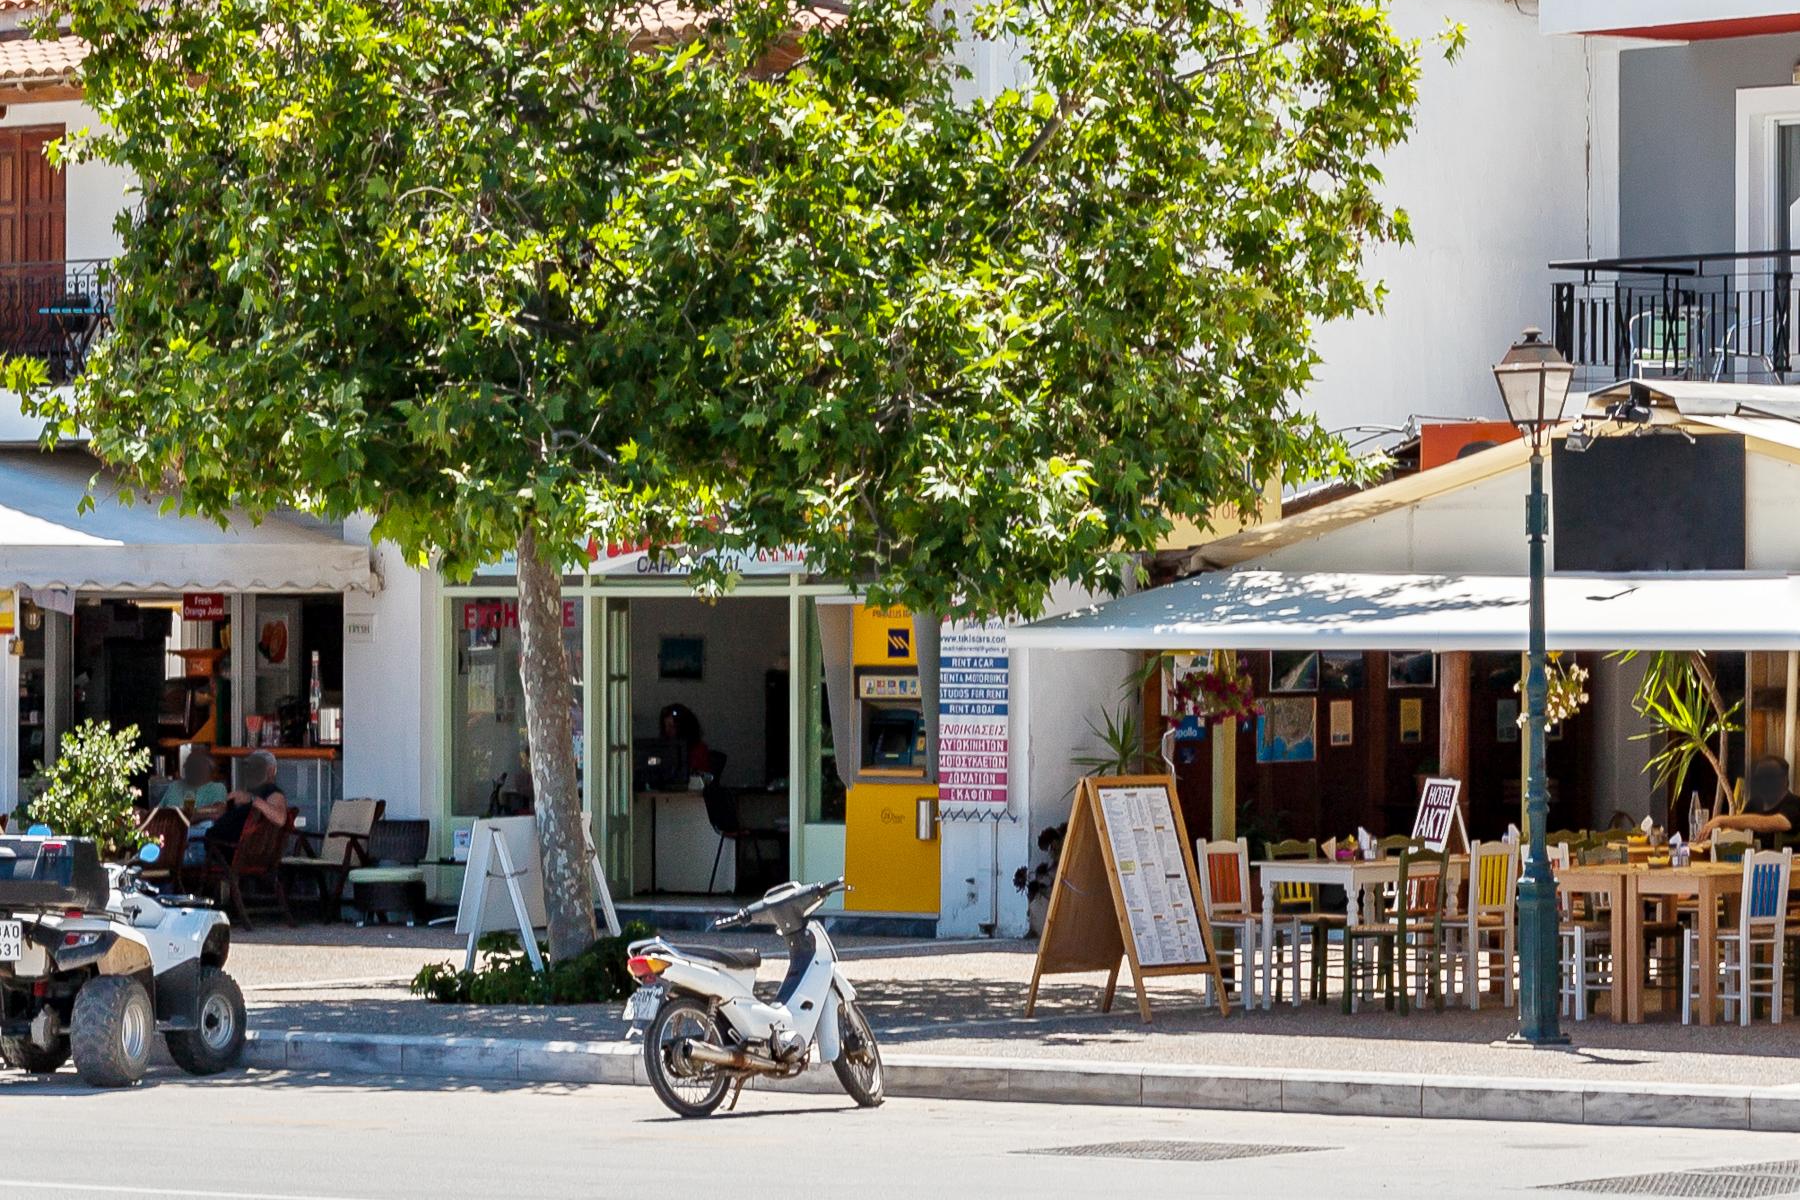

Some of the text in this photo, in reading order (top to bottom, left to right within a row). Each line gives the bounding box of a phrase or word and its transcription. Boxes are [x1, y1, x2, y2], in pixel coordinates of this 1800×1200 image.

[194, 596, 212, 606] Fresh
[184, 606, 223, 617] Orange Juice
[464, 600, 576, 630] EXCHE
[978, 658, 994, 668] CAR
[1427, 785, 1453, 807] HOTEL
[1416, 806, 1450, 839] AKTI
